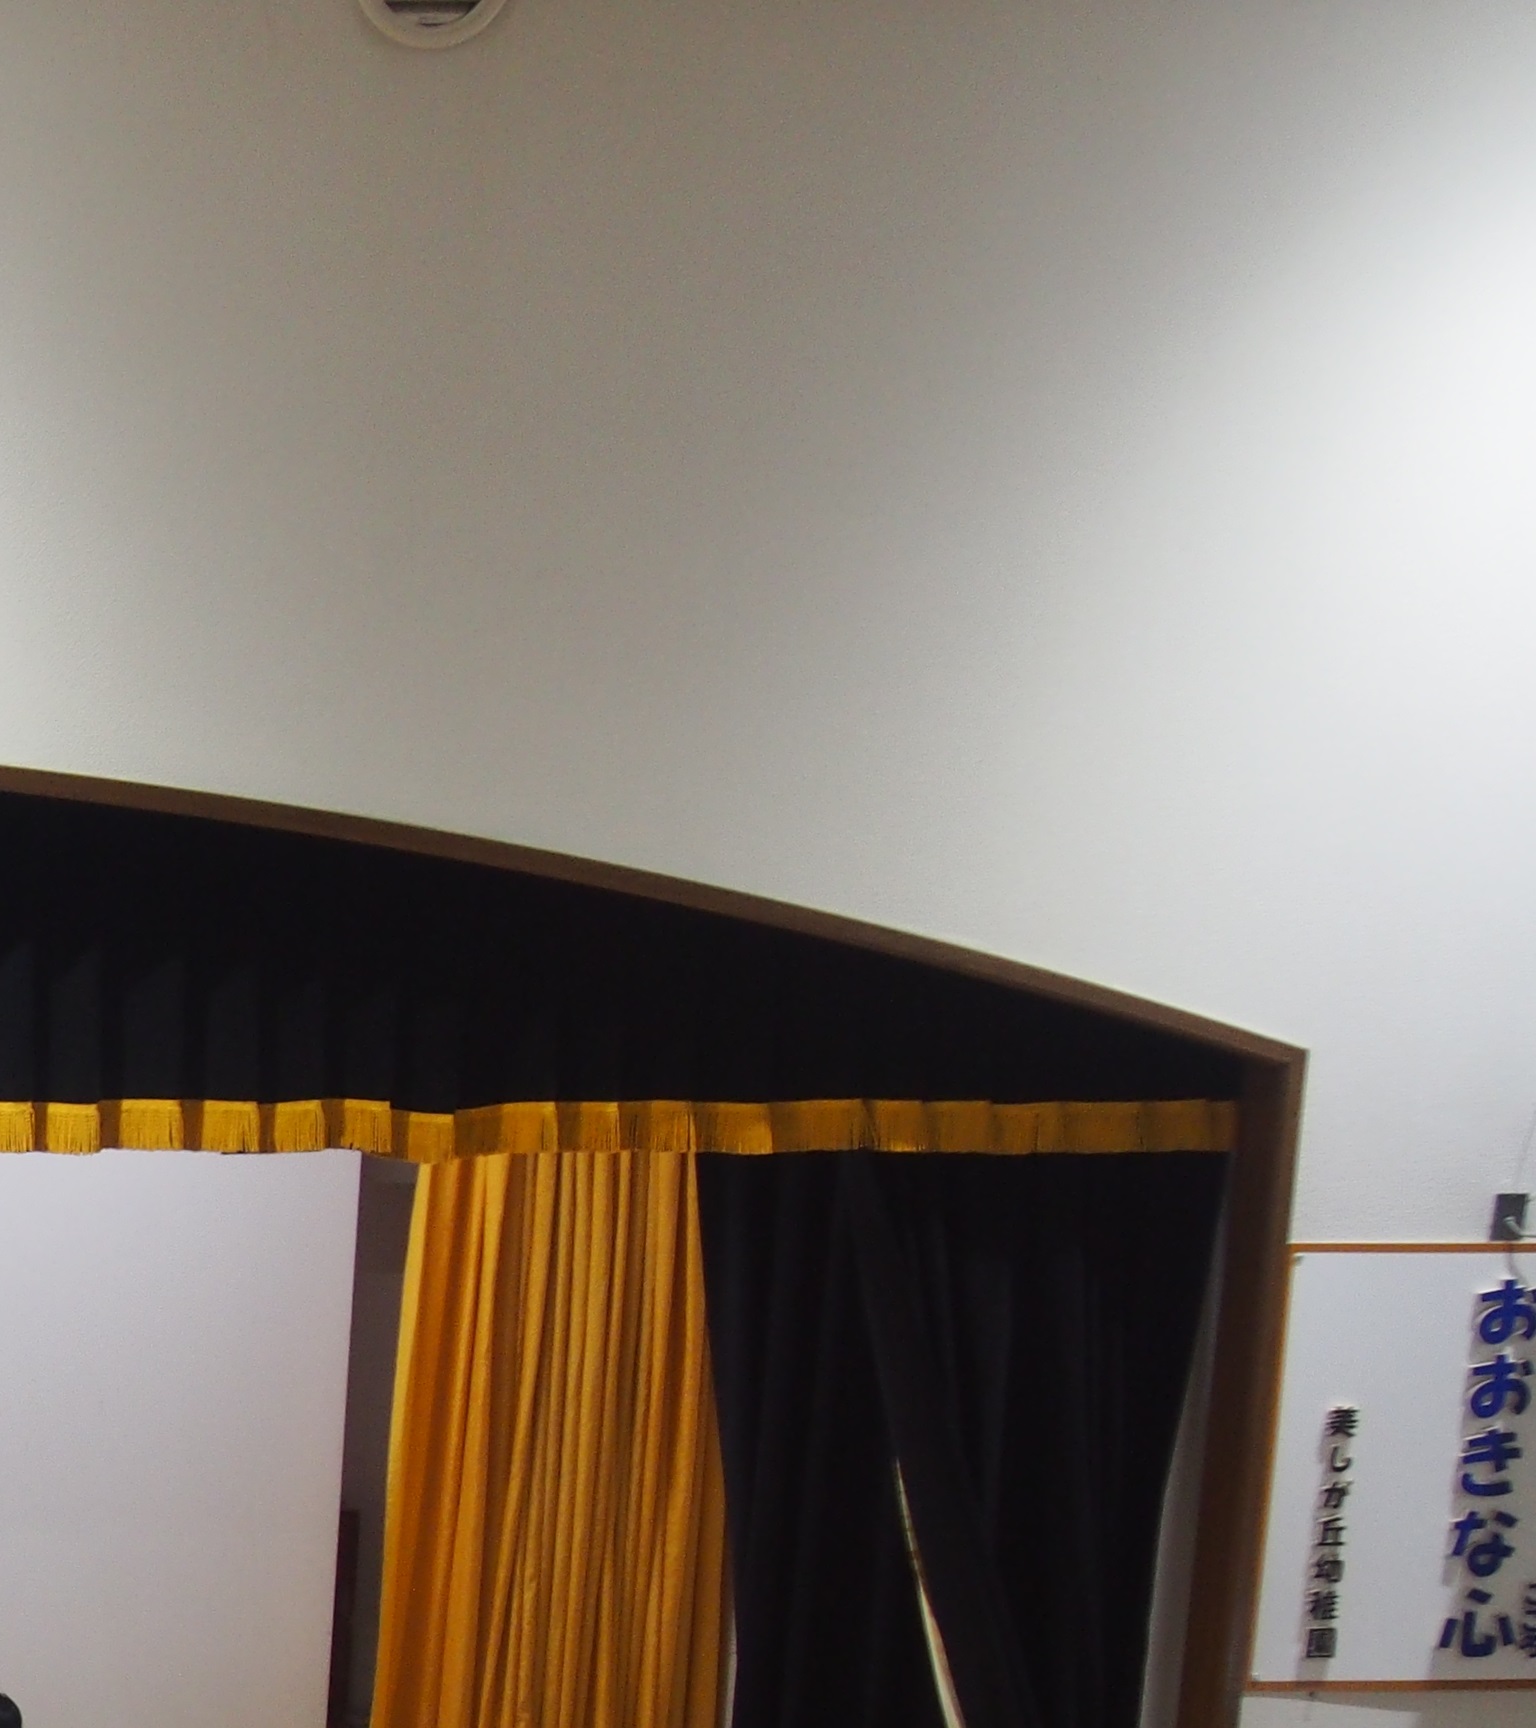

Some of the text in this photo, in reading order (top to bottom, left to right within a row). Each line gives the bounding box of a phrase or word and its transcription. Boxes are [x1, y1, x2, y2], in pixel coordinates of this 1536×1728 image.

[1438, 1279, 1536, 1659] おおきな心
